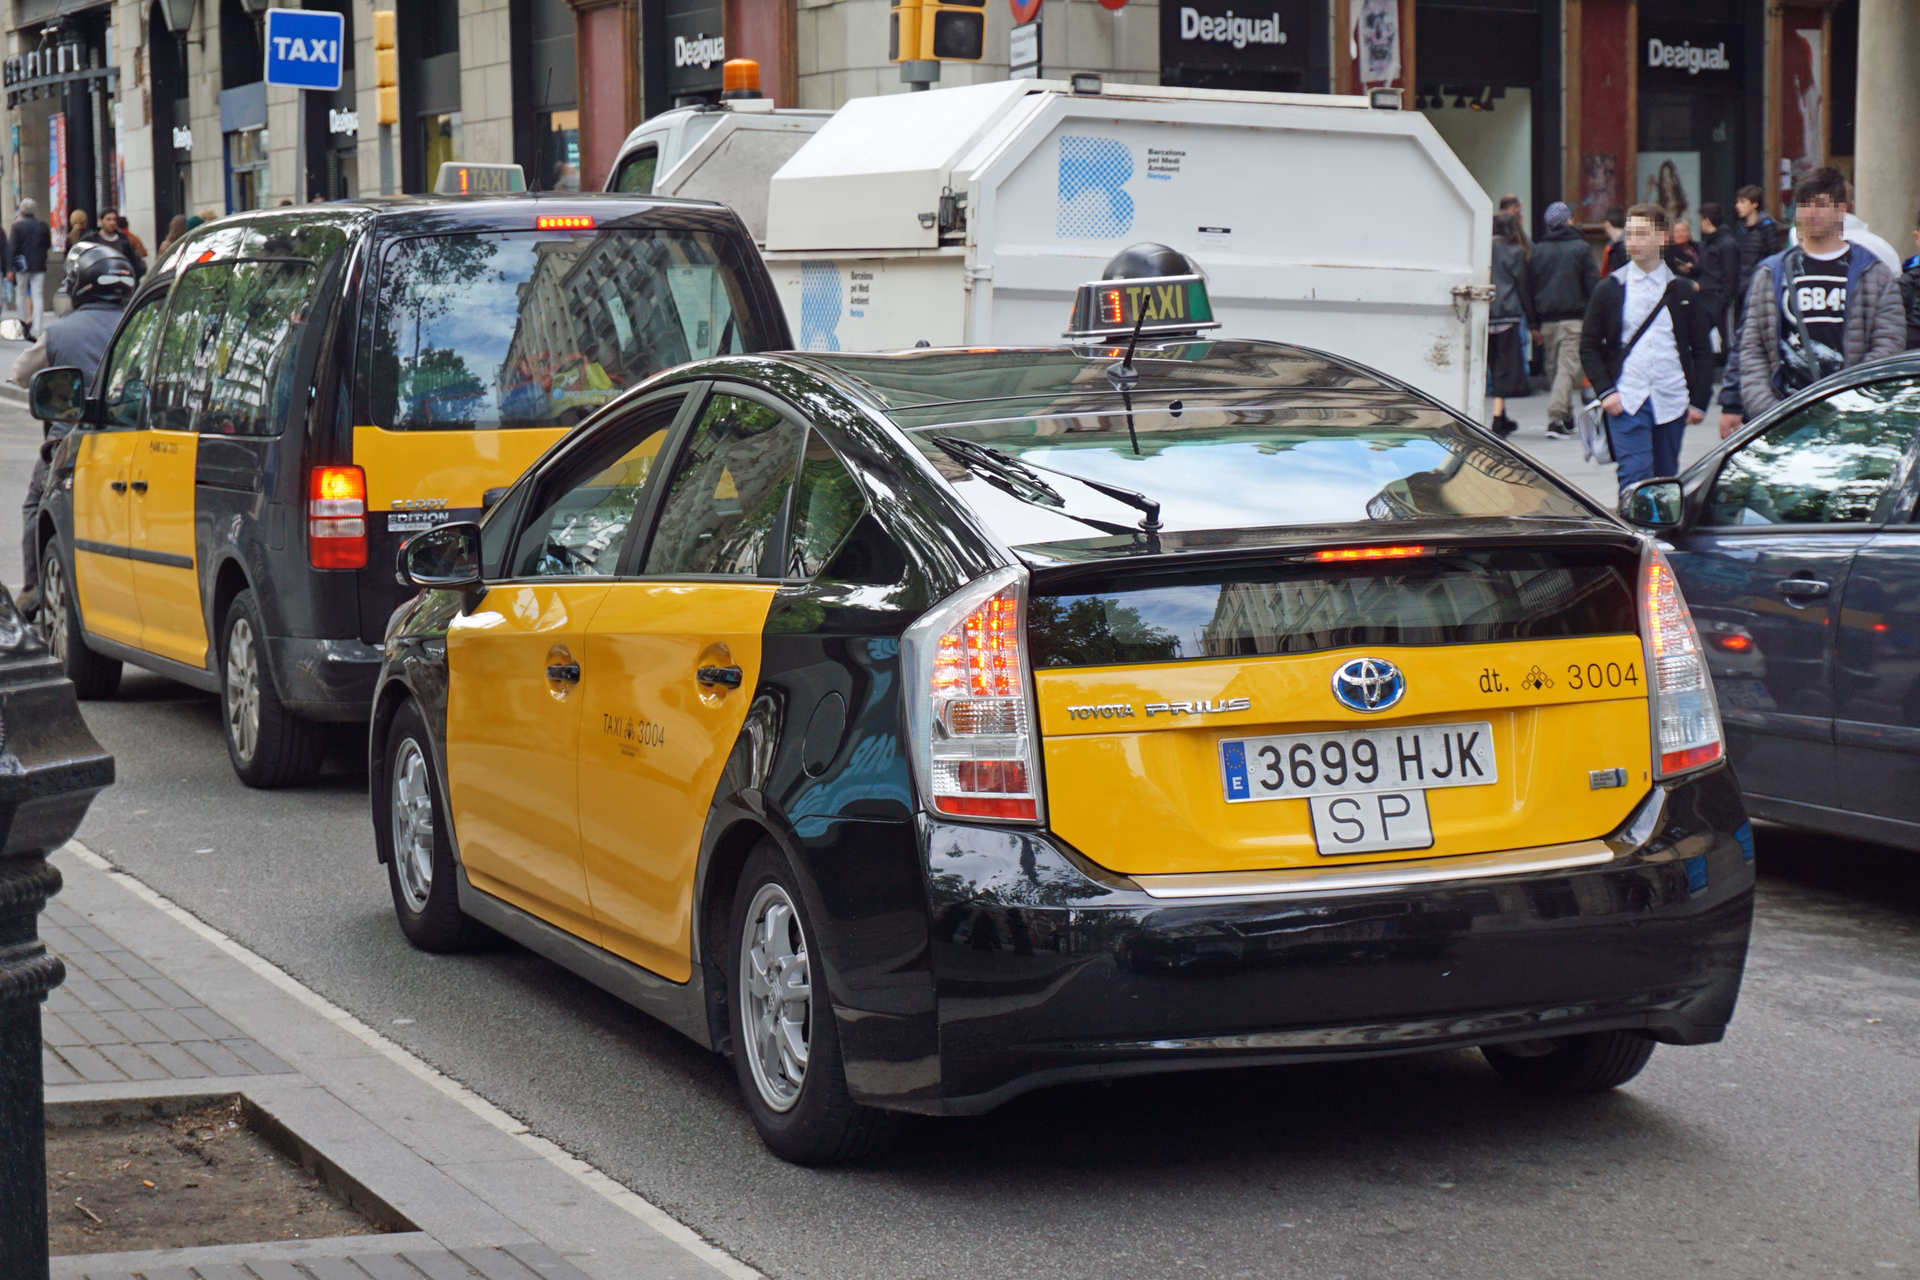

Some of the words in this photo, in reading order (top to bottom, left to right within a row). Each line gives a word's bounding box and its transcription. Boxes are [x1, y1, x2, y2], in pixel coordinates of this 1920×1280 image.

[272, 36, 337, 64] TAXI
[1148, 148, 1186, 157] Barcelona
[470, 169, 507, 192] TAXI
[1148, 165, 1180, 173] Ambient
[1126, 284, 1185, 322] TAXI
[391, 498, 449, 510] CADDY
[388, 512, 450, 524] EDITION
[1479, 668, 1510, 693] dt.
[1567, 662, 1640, 690] 3004
[1067, 703, 1135, 720] TOYOTA
[1145, 697, 1251, 717] PRIUS
[603, 713, 624, 738] TAXI
[637, 720, 665, 749] 3004
[1232, 776, 1243, 790] E
[1257, 738, 1380, 791] 3699
[1396, 731, 1484, 782] HJK
